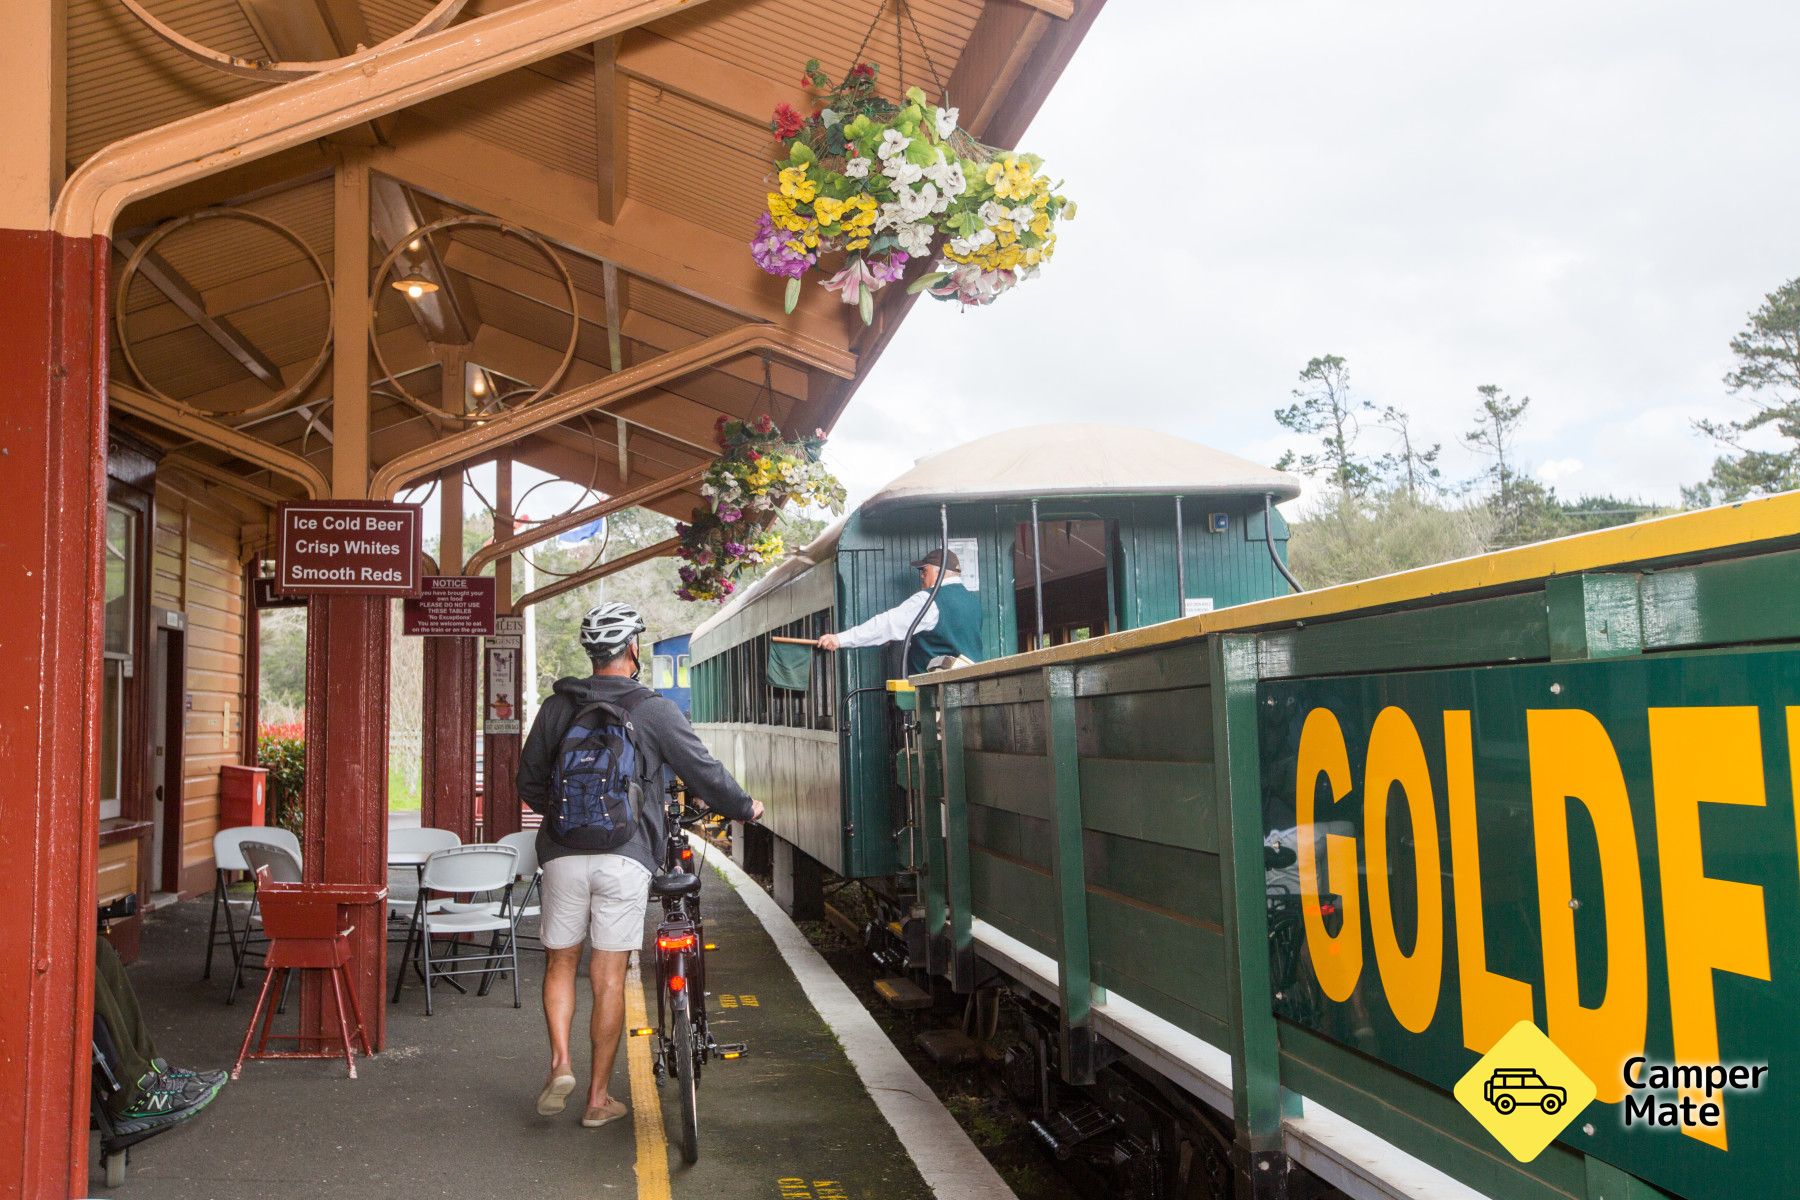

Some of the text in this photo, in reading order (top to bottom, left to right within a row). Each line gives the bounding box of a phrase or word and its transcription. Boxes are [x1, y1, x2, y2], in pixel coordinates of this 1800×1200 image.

[294, 516, 404, 531] Ice Cold Beer
[295, 539, 400, 557] Crisp Whites
[292, 565, 402, 582] Smooth Reds
[432, 579, 467, 587] NOTICE
[1296, 706, 1800, 1151] GOLDF
